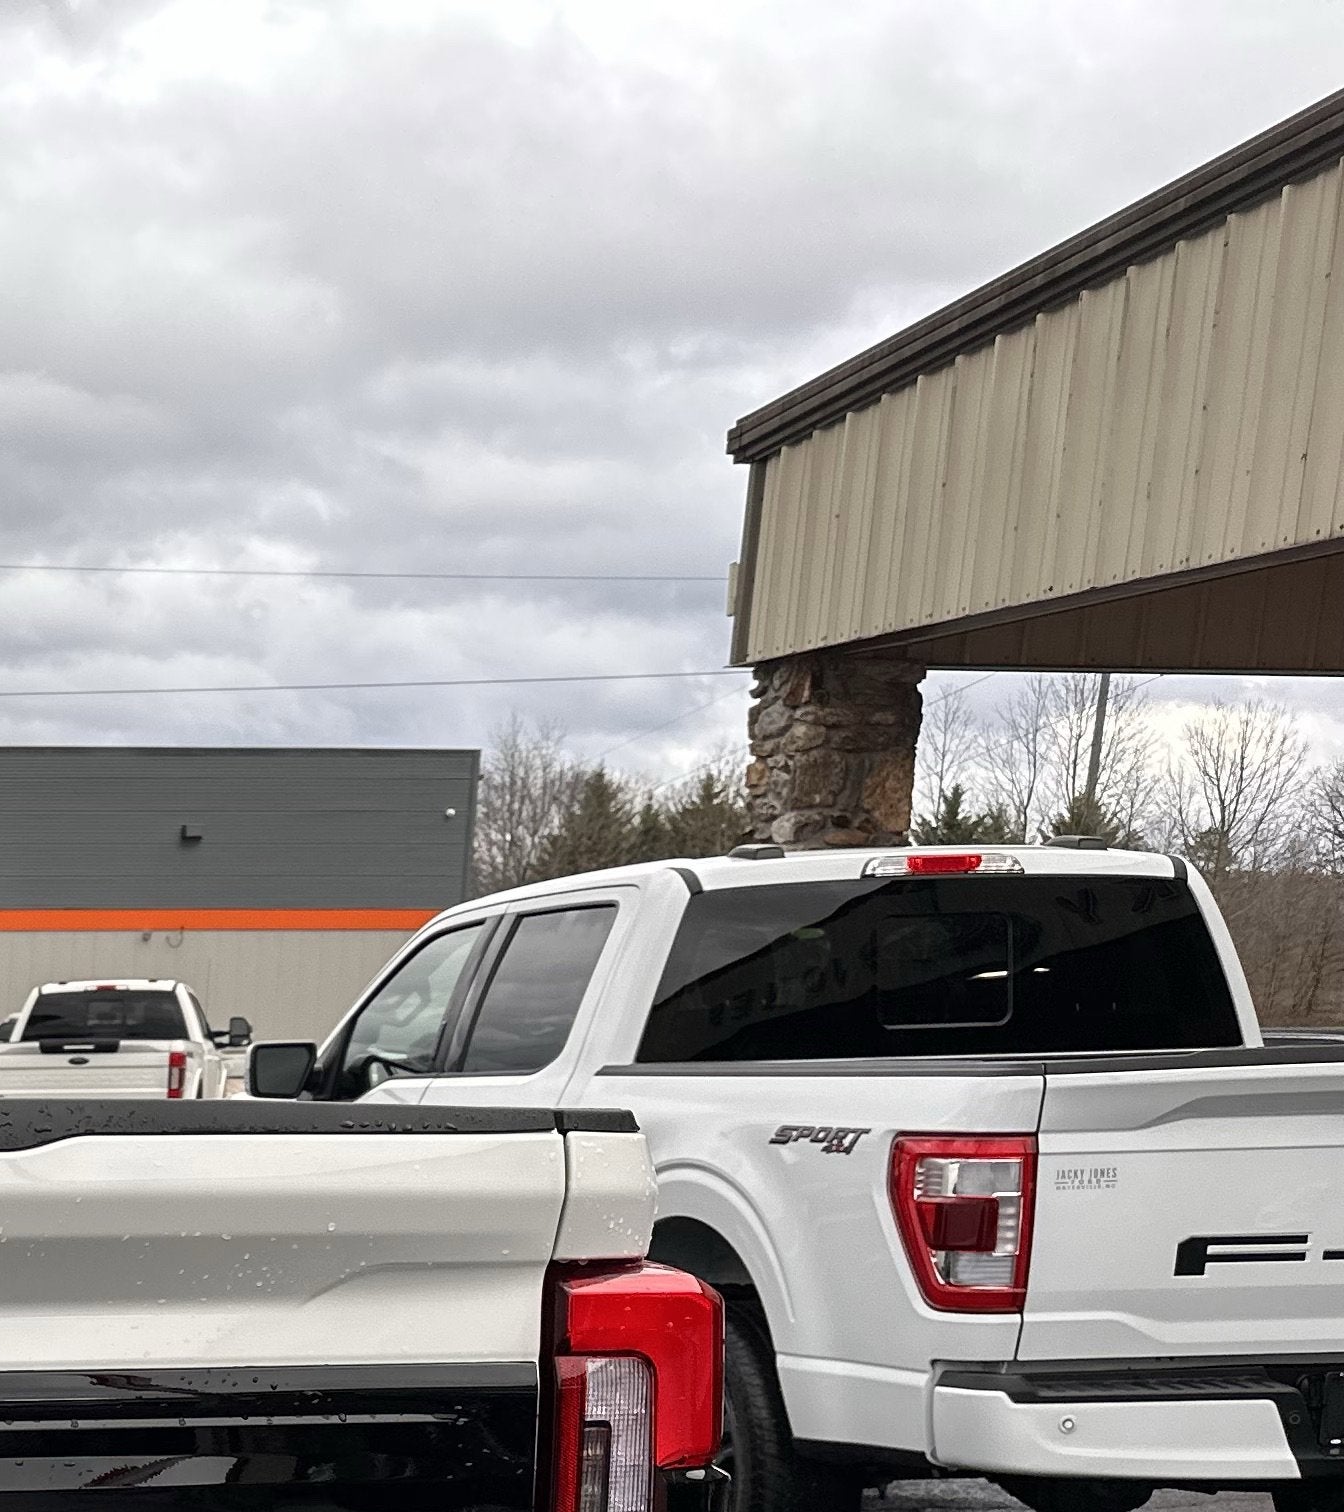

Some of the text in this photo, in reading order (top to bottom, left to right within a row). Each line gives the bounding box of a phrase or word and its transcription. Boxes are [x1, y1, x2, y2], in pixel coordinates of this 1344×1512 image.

[768, 1124, 872, 1156] SPORT
[1055, 1167, 1118, 1180] JACKY JONES
